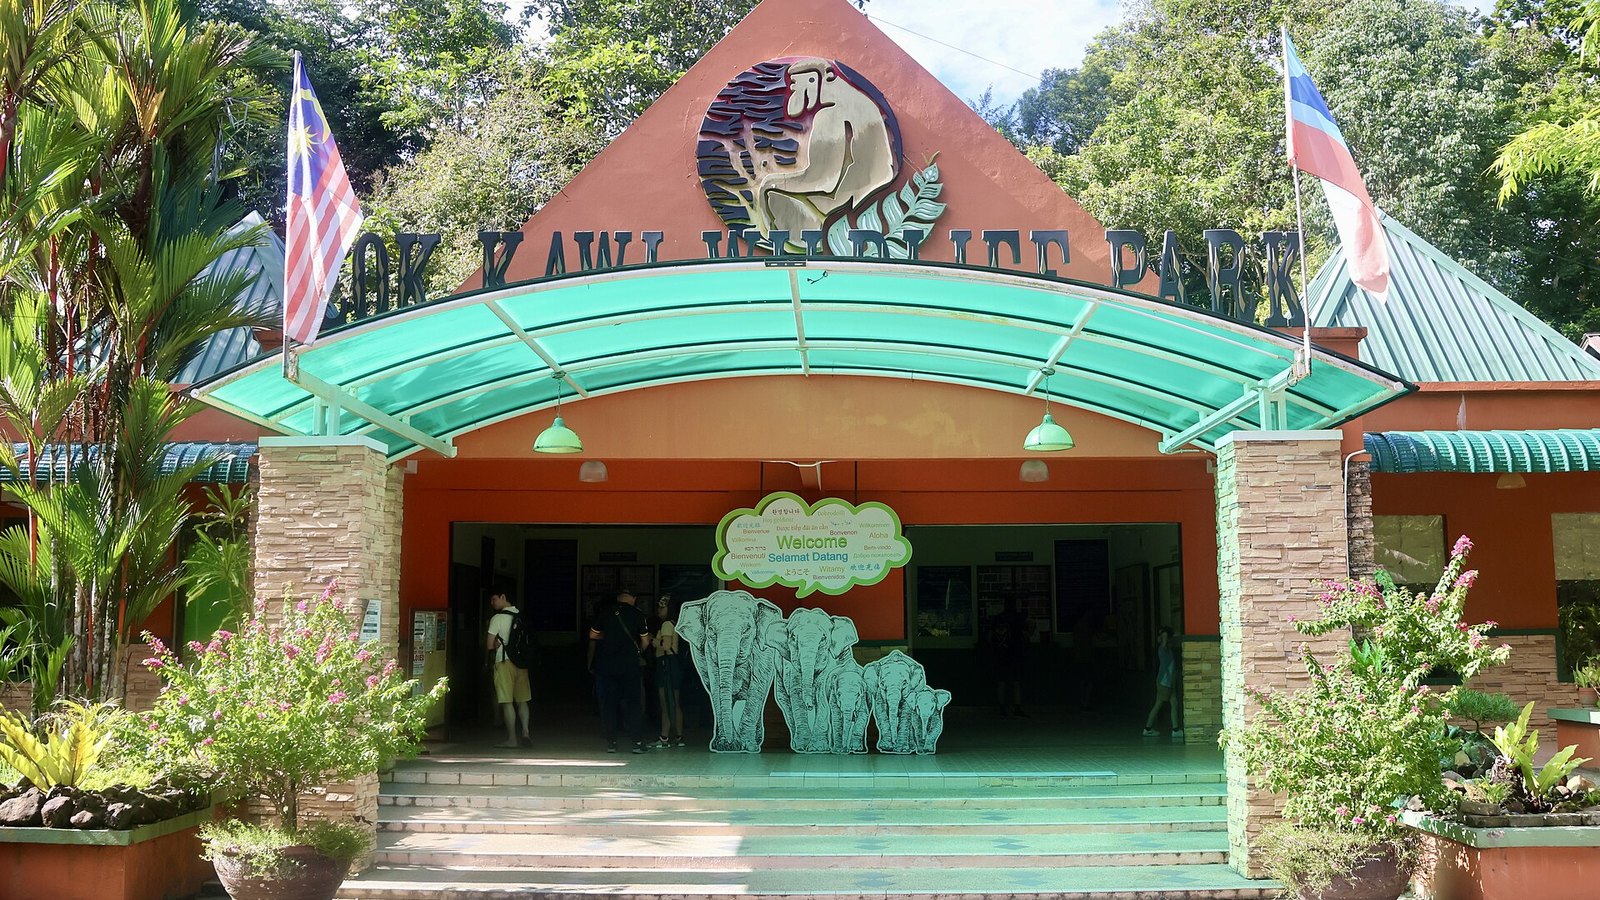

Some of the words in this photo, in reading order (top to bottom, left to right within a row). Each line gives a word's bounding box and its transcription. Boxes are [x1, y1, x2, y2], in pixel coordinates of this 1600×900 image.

[319, 232, 441, 332] OK
[1104, 229, 1303, 328] PARK
[776, 535, 848, 550] Welcome
[731, 552, 766, 560] Bienvenuti
[768, 552, 810, 563] Selamat
[812, 552, 848, 563] Datang
[819, 565, 845, 573] Witamy
